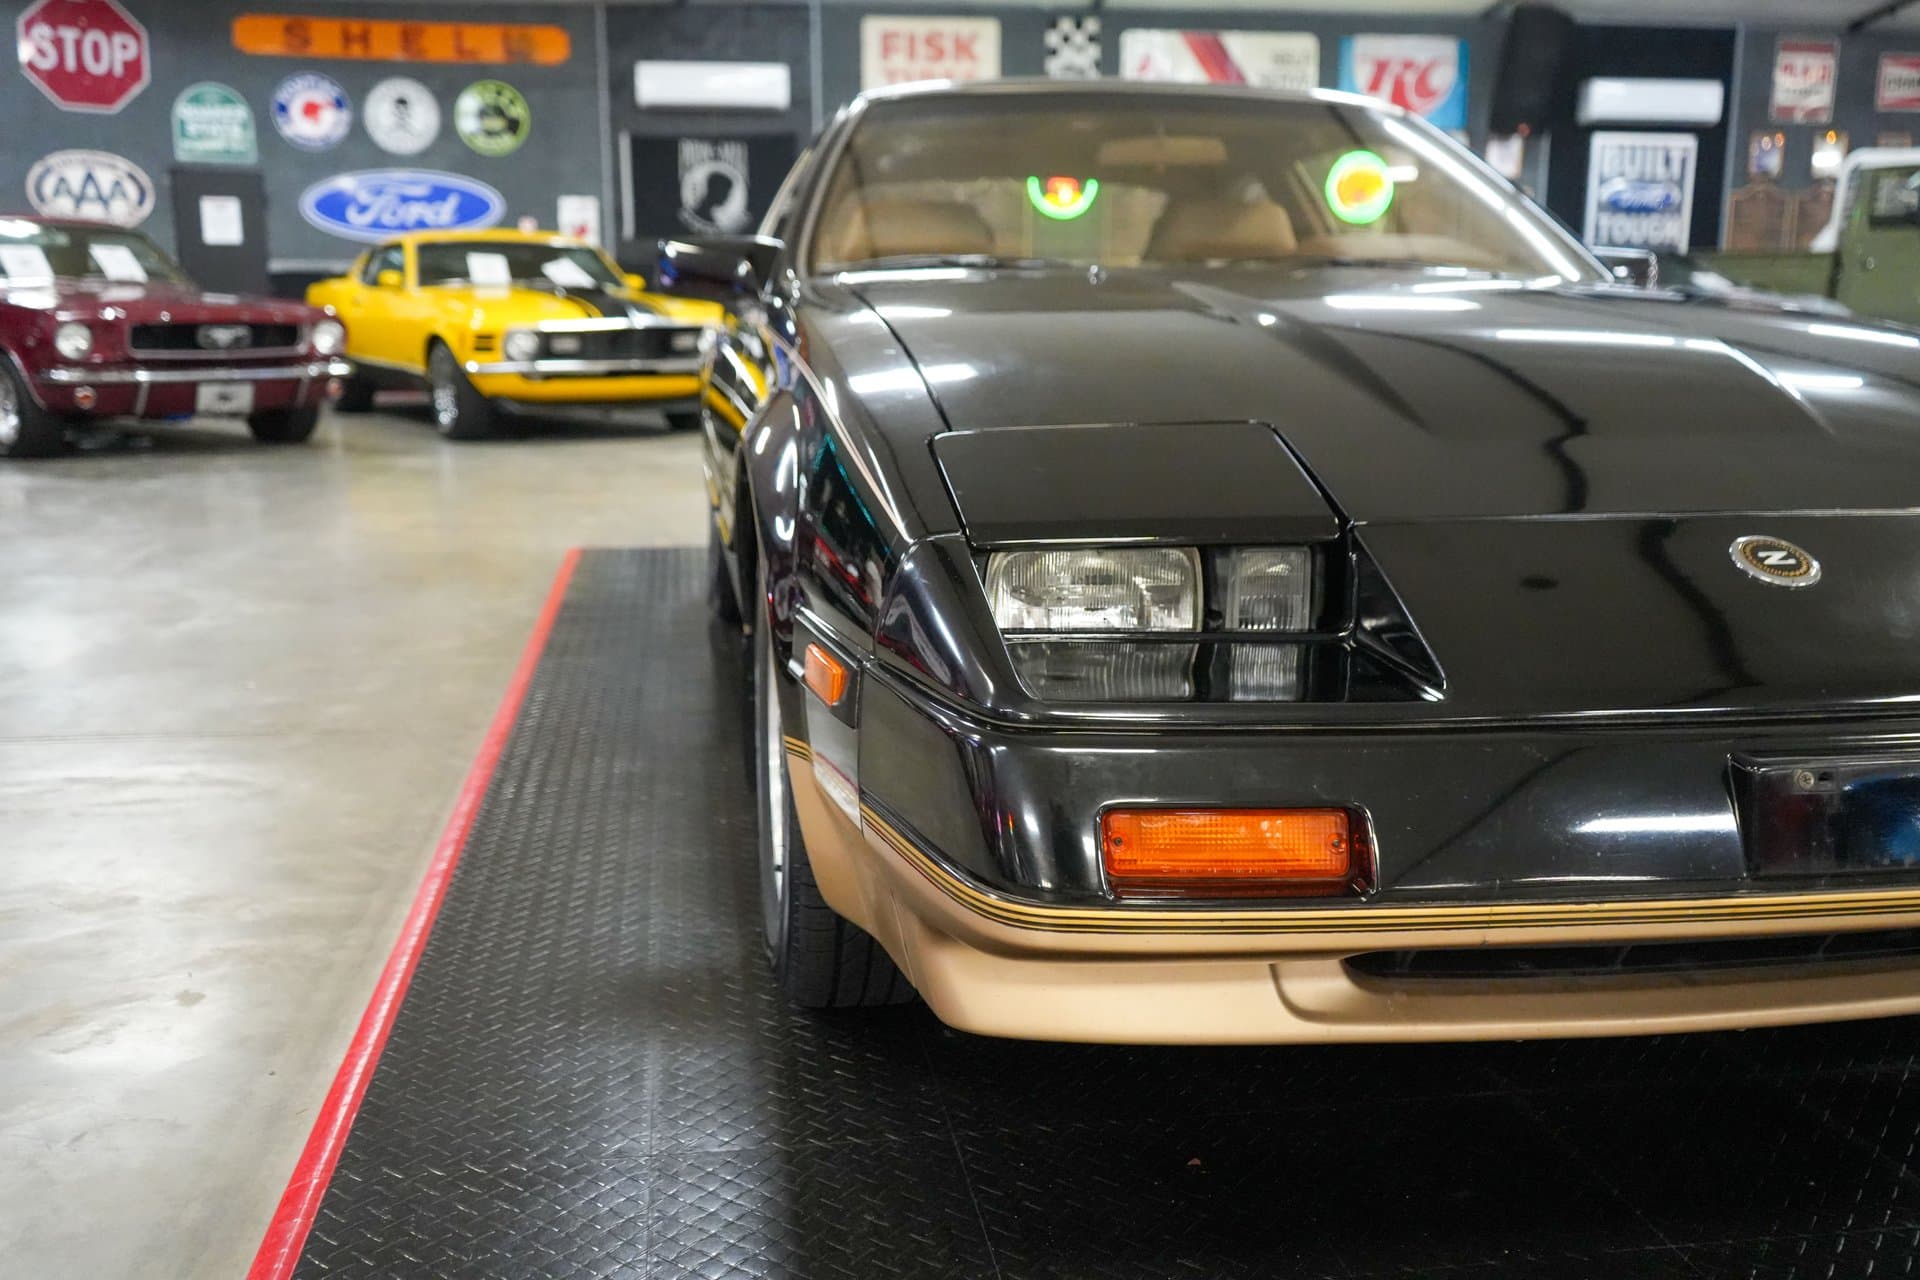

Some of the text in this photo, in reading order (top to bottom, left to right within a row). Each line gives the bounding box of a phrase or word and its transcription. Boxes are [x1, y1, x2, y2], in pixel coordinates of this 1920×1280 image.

[28, 23, 140, 78] STOP
[881, 31, 978, 61] FISK
[1601, 145, 1689, 182] BUILT
[53, 170, 130, 210] AAA
[345, 182, 461, 227] Ford
[1595, 214, 1685, 247] TOUGH
